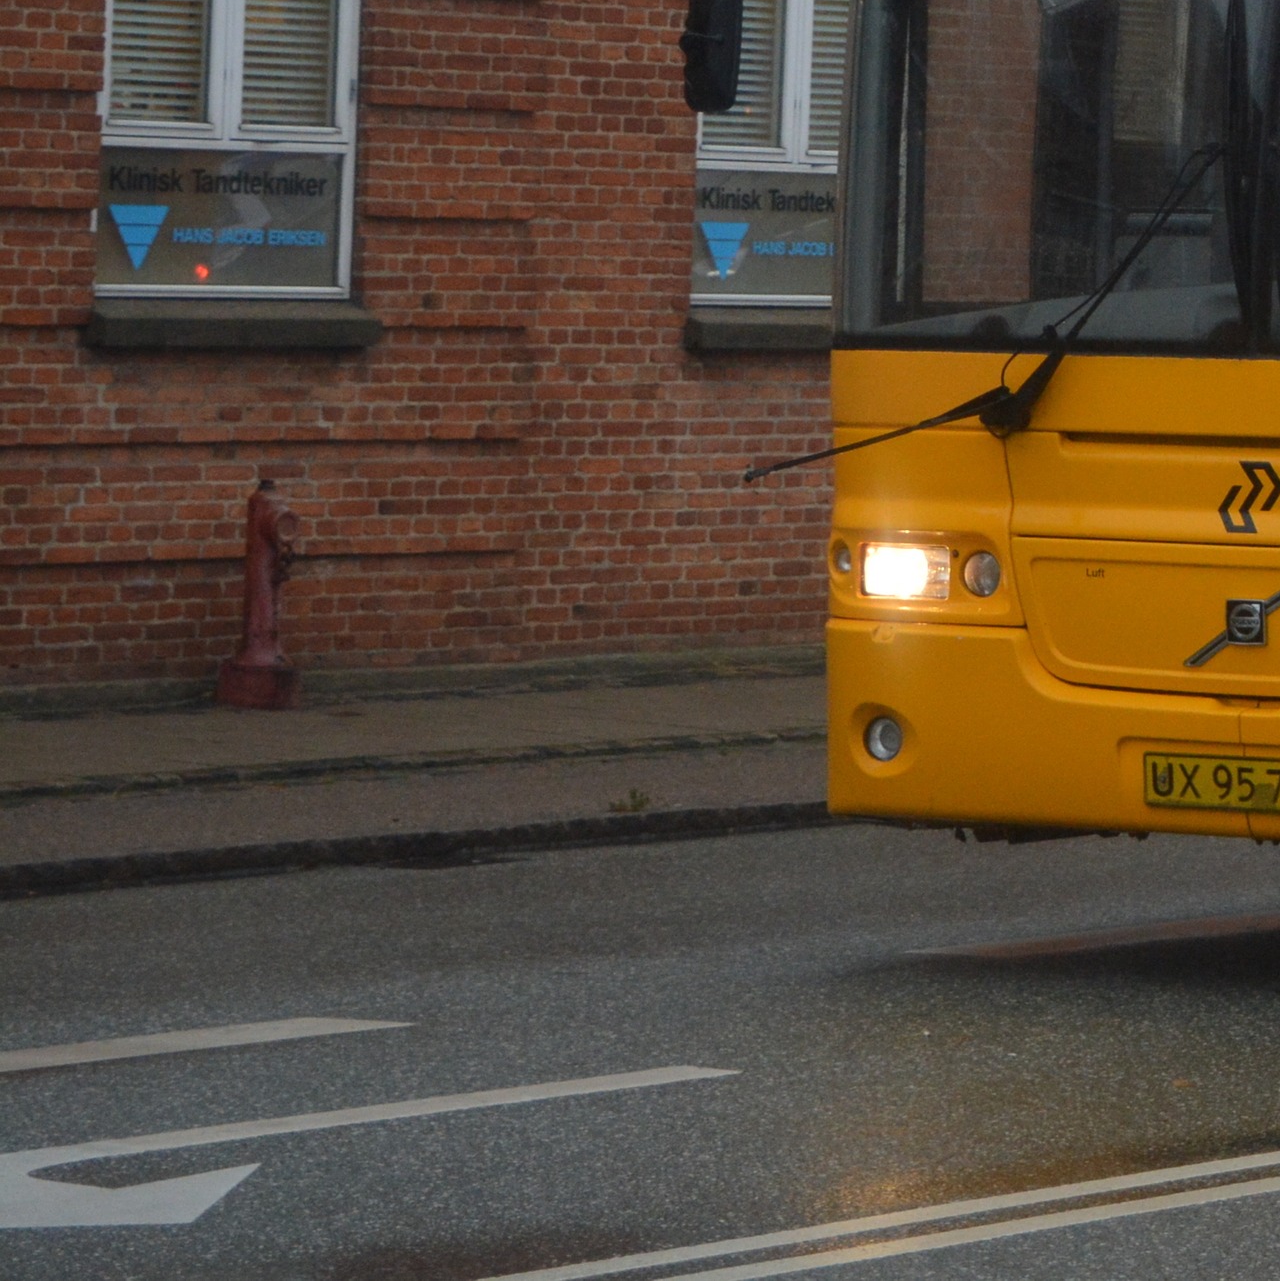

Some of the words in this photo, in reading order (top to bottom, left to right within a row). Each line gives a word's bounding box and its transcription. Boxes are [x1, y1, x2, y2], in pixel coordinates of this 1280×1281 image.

[108, 166, 183, 193] Klinisk
[192, 169, 328, 197] Tandtekniker
[701, 186, 762, 211] Klinisk
[172, 227, 214, 245] HANS
[218, 228, 264, 246] JACOB
[268, 229, 328, 247] ERIKSEN
[753, 240, 785, 255] HANS
[788, 241, 826, 257] JACOB
[1086, 567, 1105, 578] Luft
[1152, 761, 1201, 799] UX
[1212, 764, 1255, 803] 95
